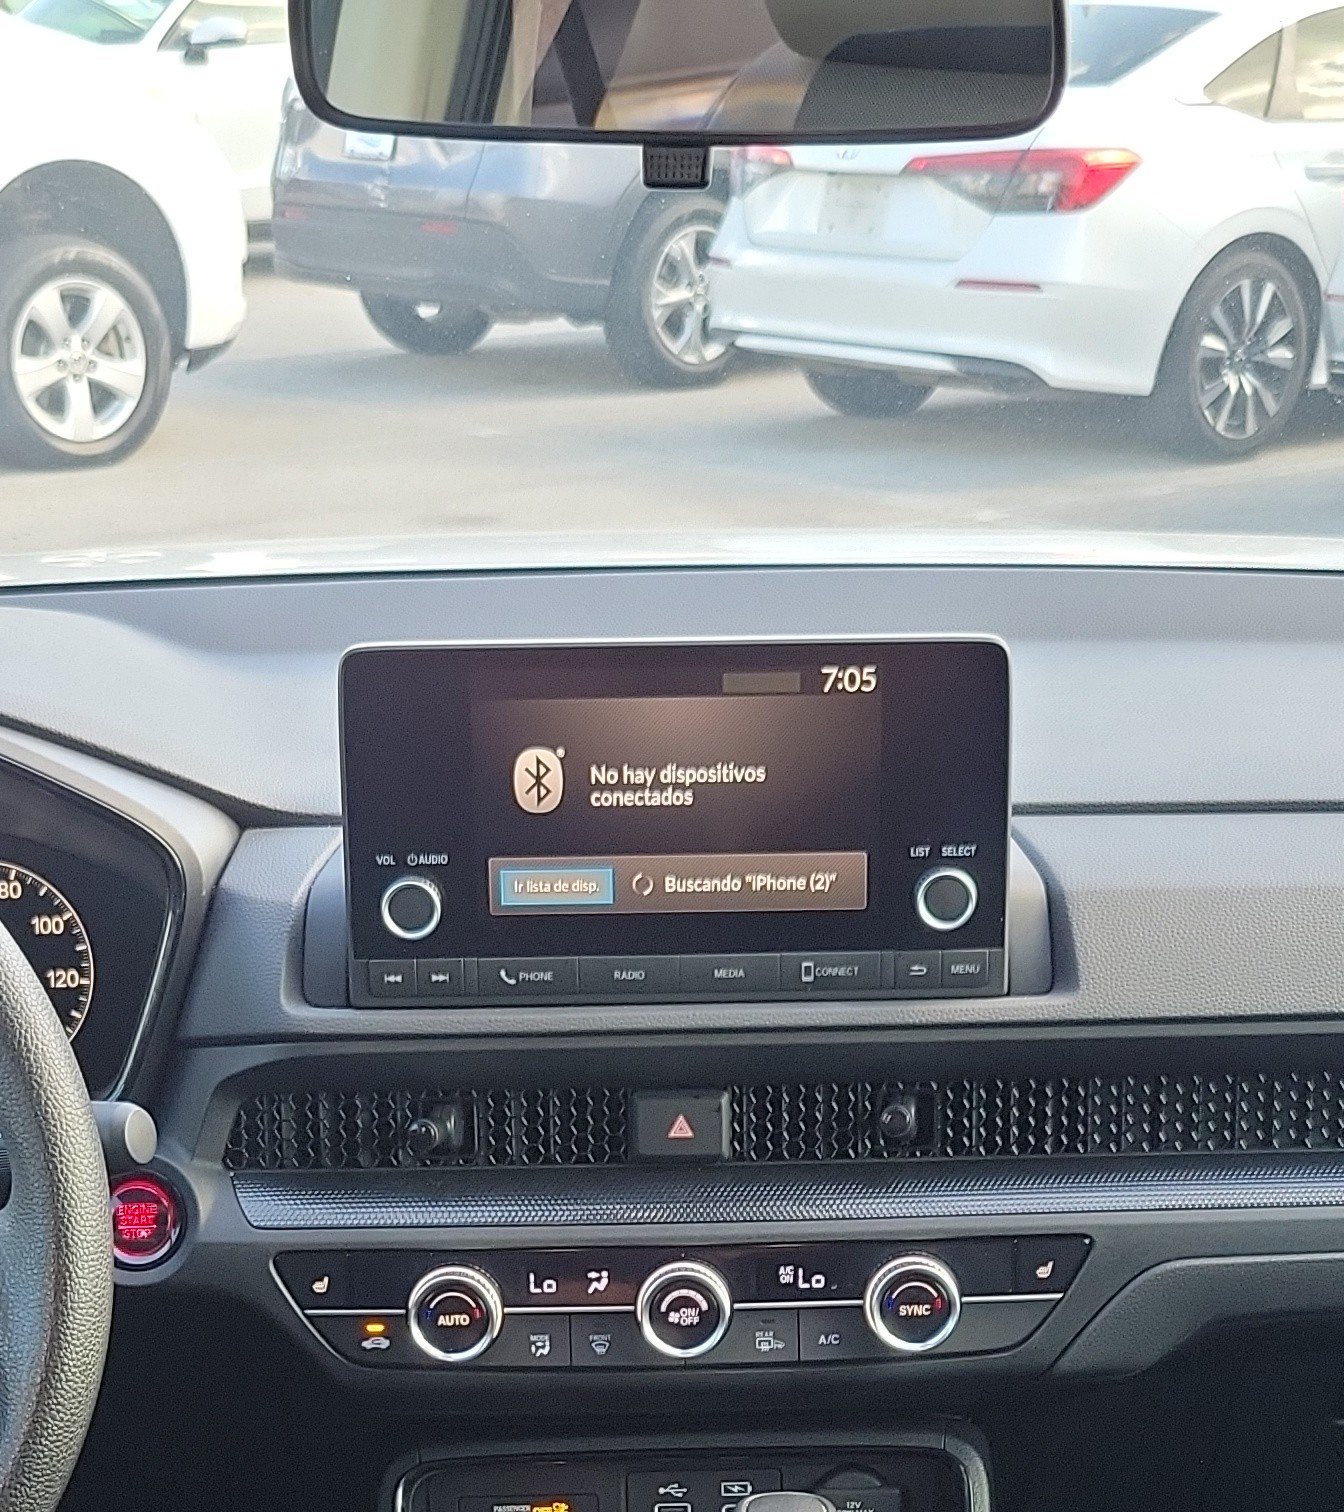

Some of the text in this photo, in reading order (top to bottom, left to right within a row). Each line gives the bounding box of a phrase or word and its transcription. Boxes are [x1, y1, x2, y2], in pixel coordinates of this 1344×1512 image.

[821, 664, 877, 693] 7:05
[590, 762, 767, 789] No hay dispositivos
[590, 787, 694, 807] conectados
[910, 845, 977, 858] LIST SELECT
[376, 853, 449, 866] VOL AUDIO
[514, 877, 600, 895] Ir lista de disp.
[664, 874, 743, 893] Buscando
[809, 871, 838, 893] (2)"
[31, 916, 64, 935] 100
[713, 968, 745, 979] MEDIA
[815, 965, 859, 977] CONNECT
[950, 963, 980, 975] MENU
[46, 969, 80, 989] 120
[518, 970, 554, 982] PHONE
[613, 970, 646, 981] RADIO
[117, 1202, 158, 1215] ENGINE
[119, 1214, 155, 1226] START
[123, 1228, 152, 1239] STOP
[778, 1265, 794, 1275] A/C
[529, 1272, 557, 1294] Lo
[780, 1274, 794, 1284] ON
[798, 1267, 826, 1289] Lo
[679, 1307, 700, 1317] ON/
[898, 1304, 931, 1317] SYNC
[437, 1315, 471, 1327] AUTO
[679, 1316, 700, 1327] OFF
[530, 1334, 550, 1343] MODE
[589, 1334, 612, 1342] FRONT
[818, 1333, 840, 1346] A/C
[493, 1504, 531, 1512] PASSENGER
[846, 1501, 862, 1509] 12V
